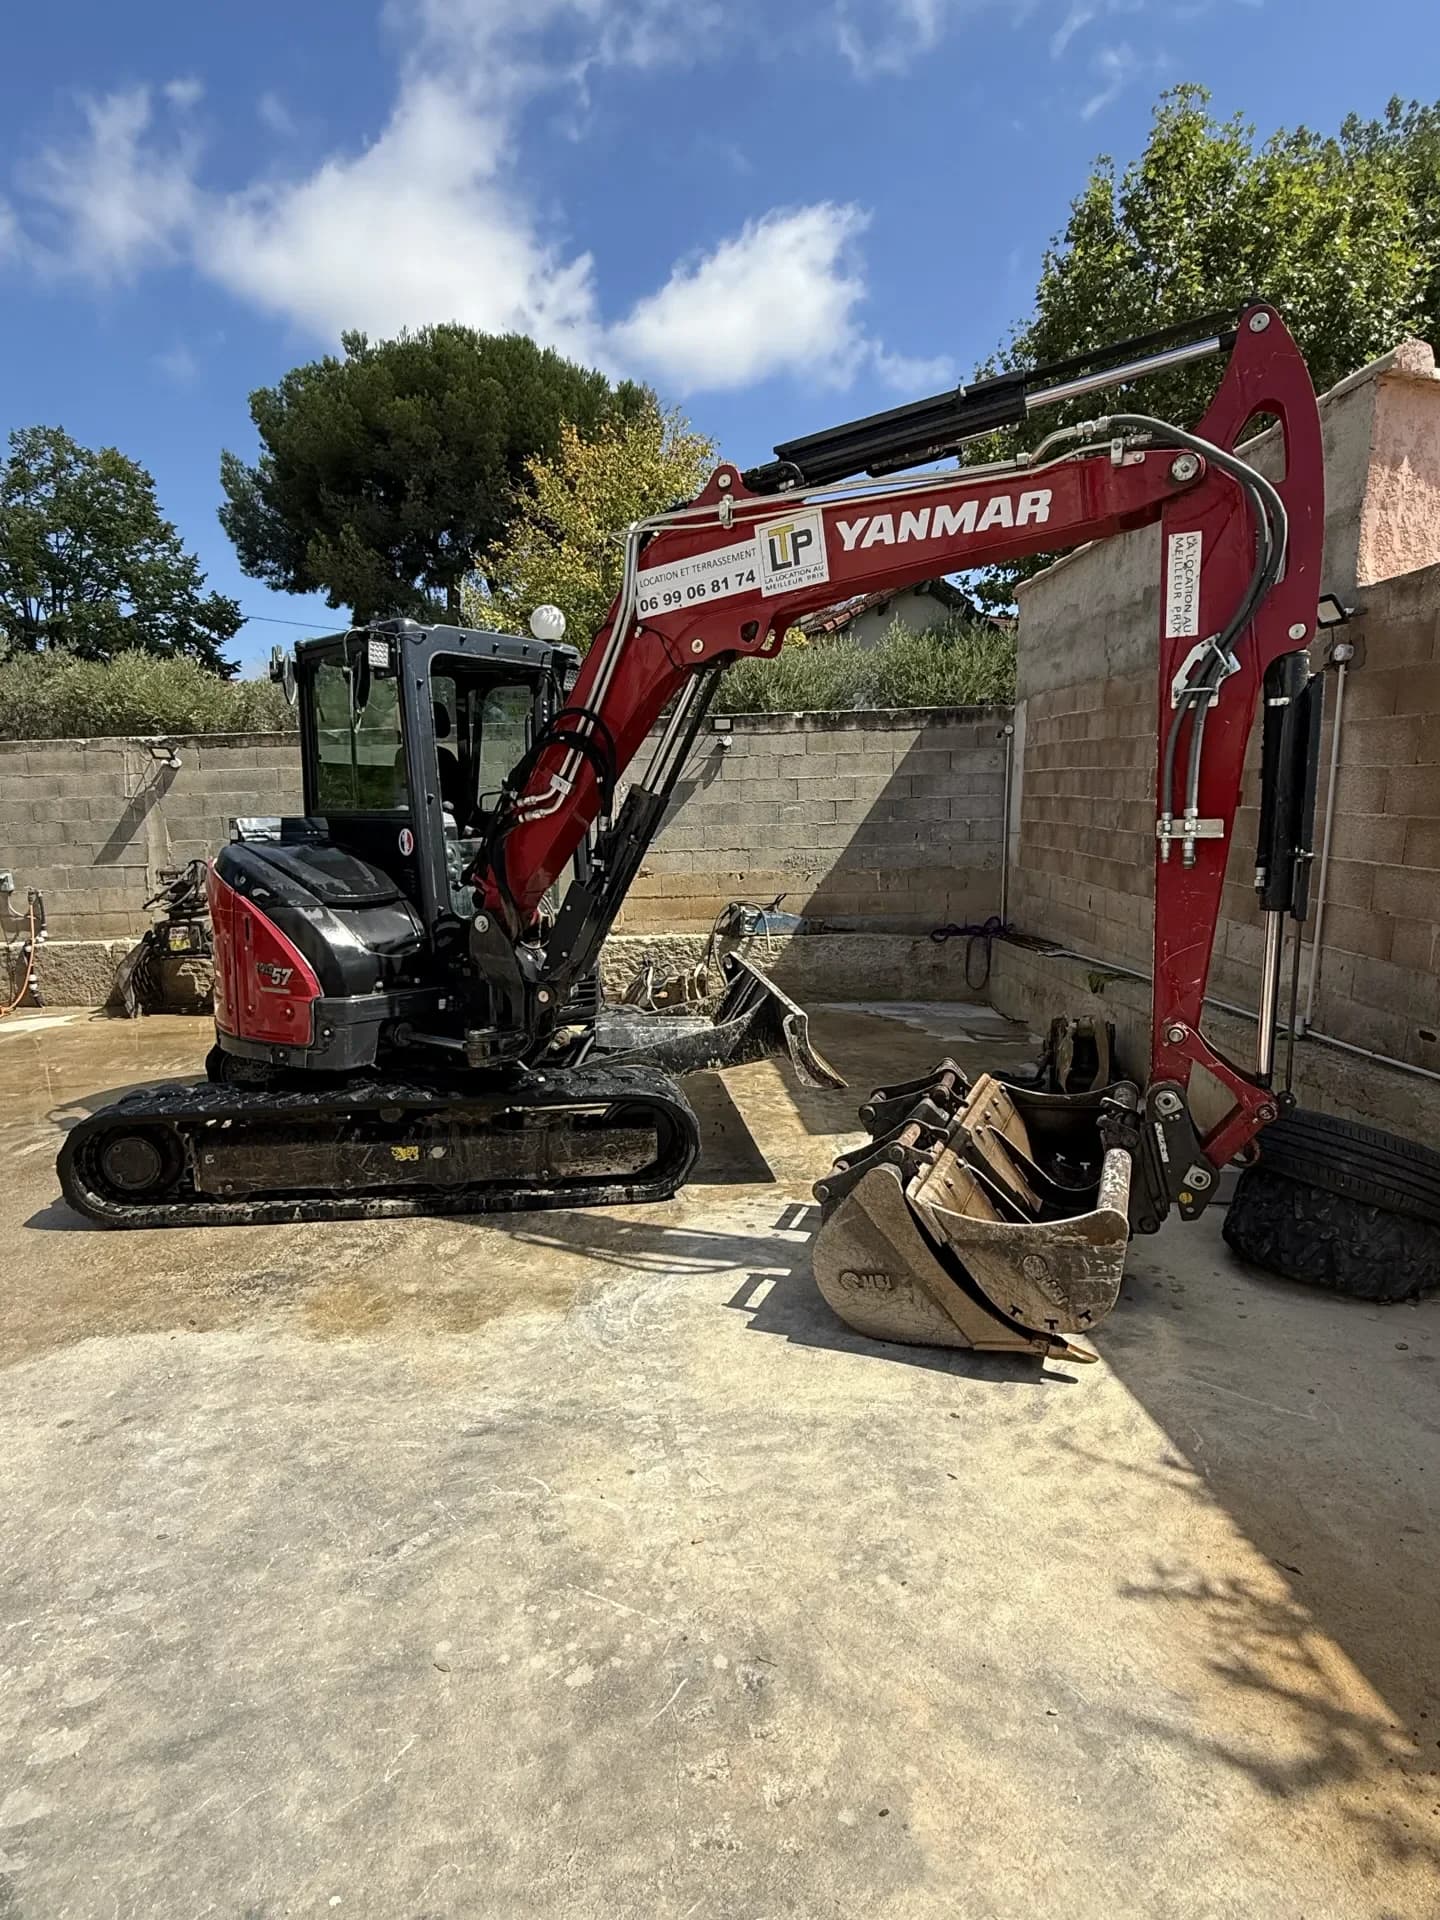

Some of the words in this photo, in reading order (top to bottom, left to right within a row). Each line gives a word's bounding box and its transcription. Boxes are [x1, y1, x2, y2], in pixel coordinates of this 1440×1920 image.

[835, 488, 1053, 551] YANMAR
[1186, 534, 1195, 550] LA
[639, 570, 679, 588] LOCATION
[680, 567, 690, 577] ET
[692, 547, 757, 573] TERRASSEMENT
[765, 577, 803, 591] MEILLEUR
[806, 571, 825, 580] PRIX
[775, 568, 811, 581] LOCATION
[813, 564, 824, 572] AU
[1173, 537, 1184, 599] MEILLEUR
[1183, 553, 1194, 613] LOCATION
[639, 596, 659, 612] 06
[662, 590, 682, 606] 99
[686, 583, 706, 600] 06
[711, 576, 729, 593] 81
[734, 569, 756, 587] 74
[1172, 606, 1182, 633] PRIX
[1183, 618, 1192, 633] AU
